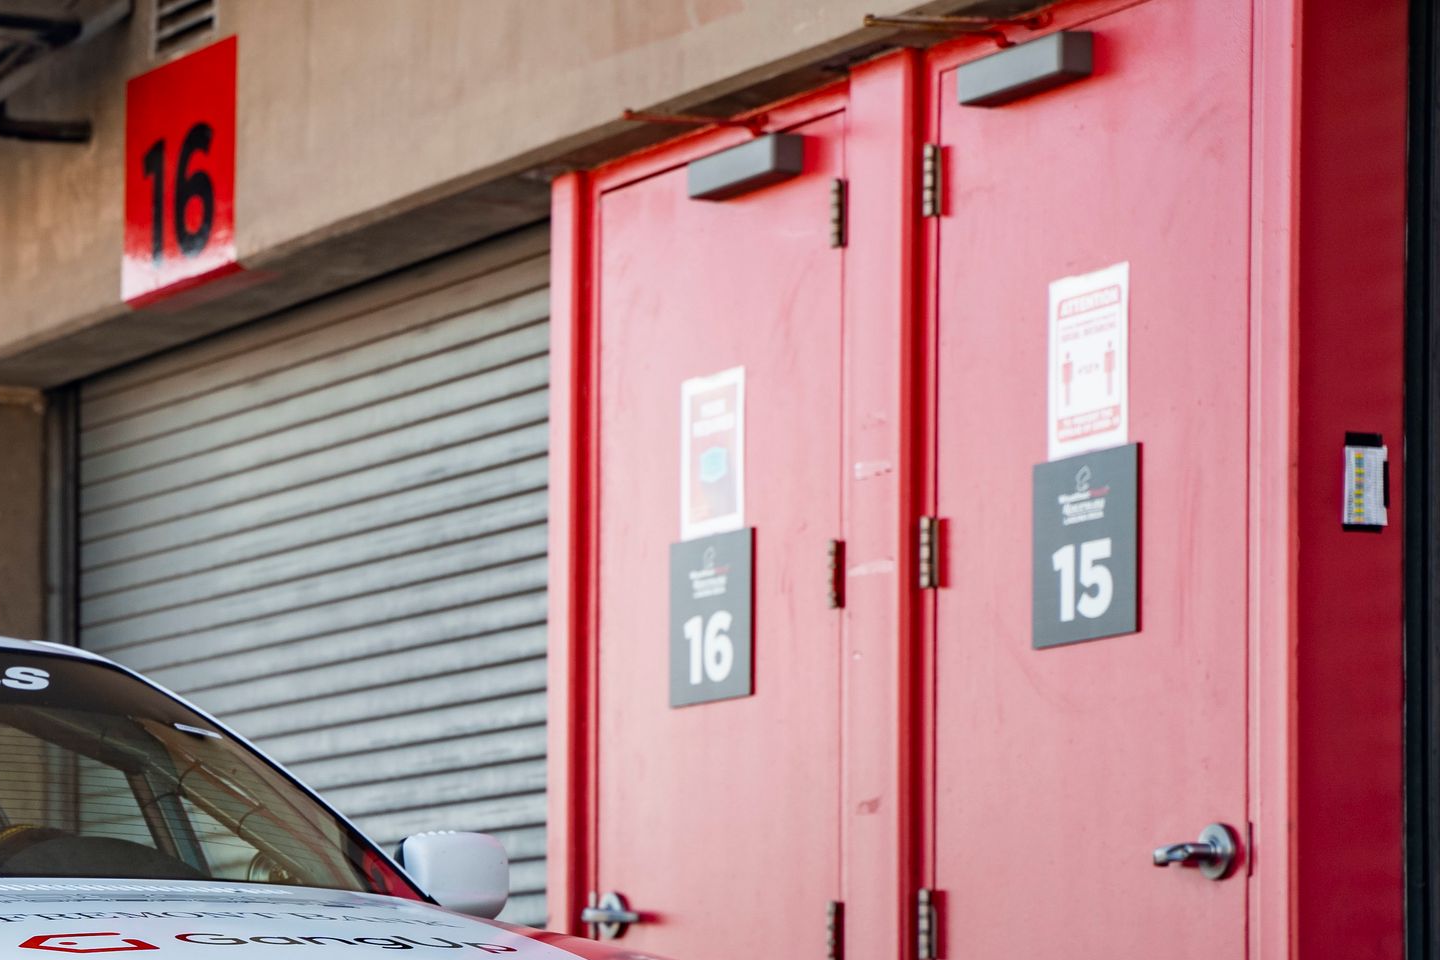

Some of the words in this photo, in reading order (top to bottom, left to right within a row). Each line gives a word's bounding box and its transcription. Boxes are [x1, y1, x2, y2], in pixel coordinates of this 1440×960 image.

[143, 122, 214, 268] 16
[1052, 537, 1113, 622] 15
[683, 610, 733, 685] 16
[175, 933, 517, 955] GangUp
